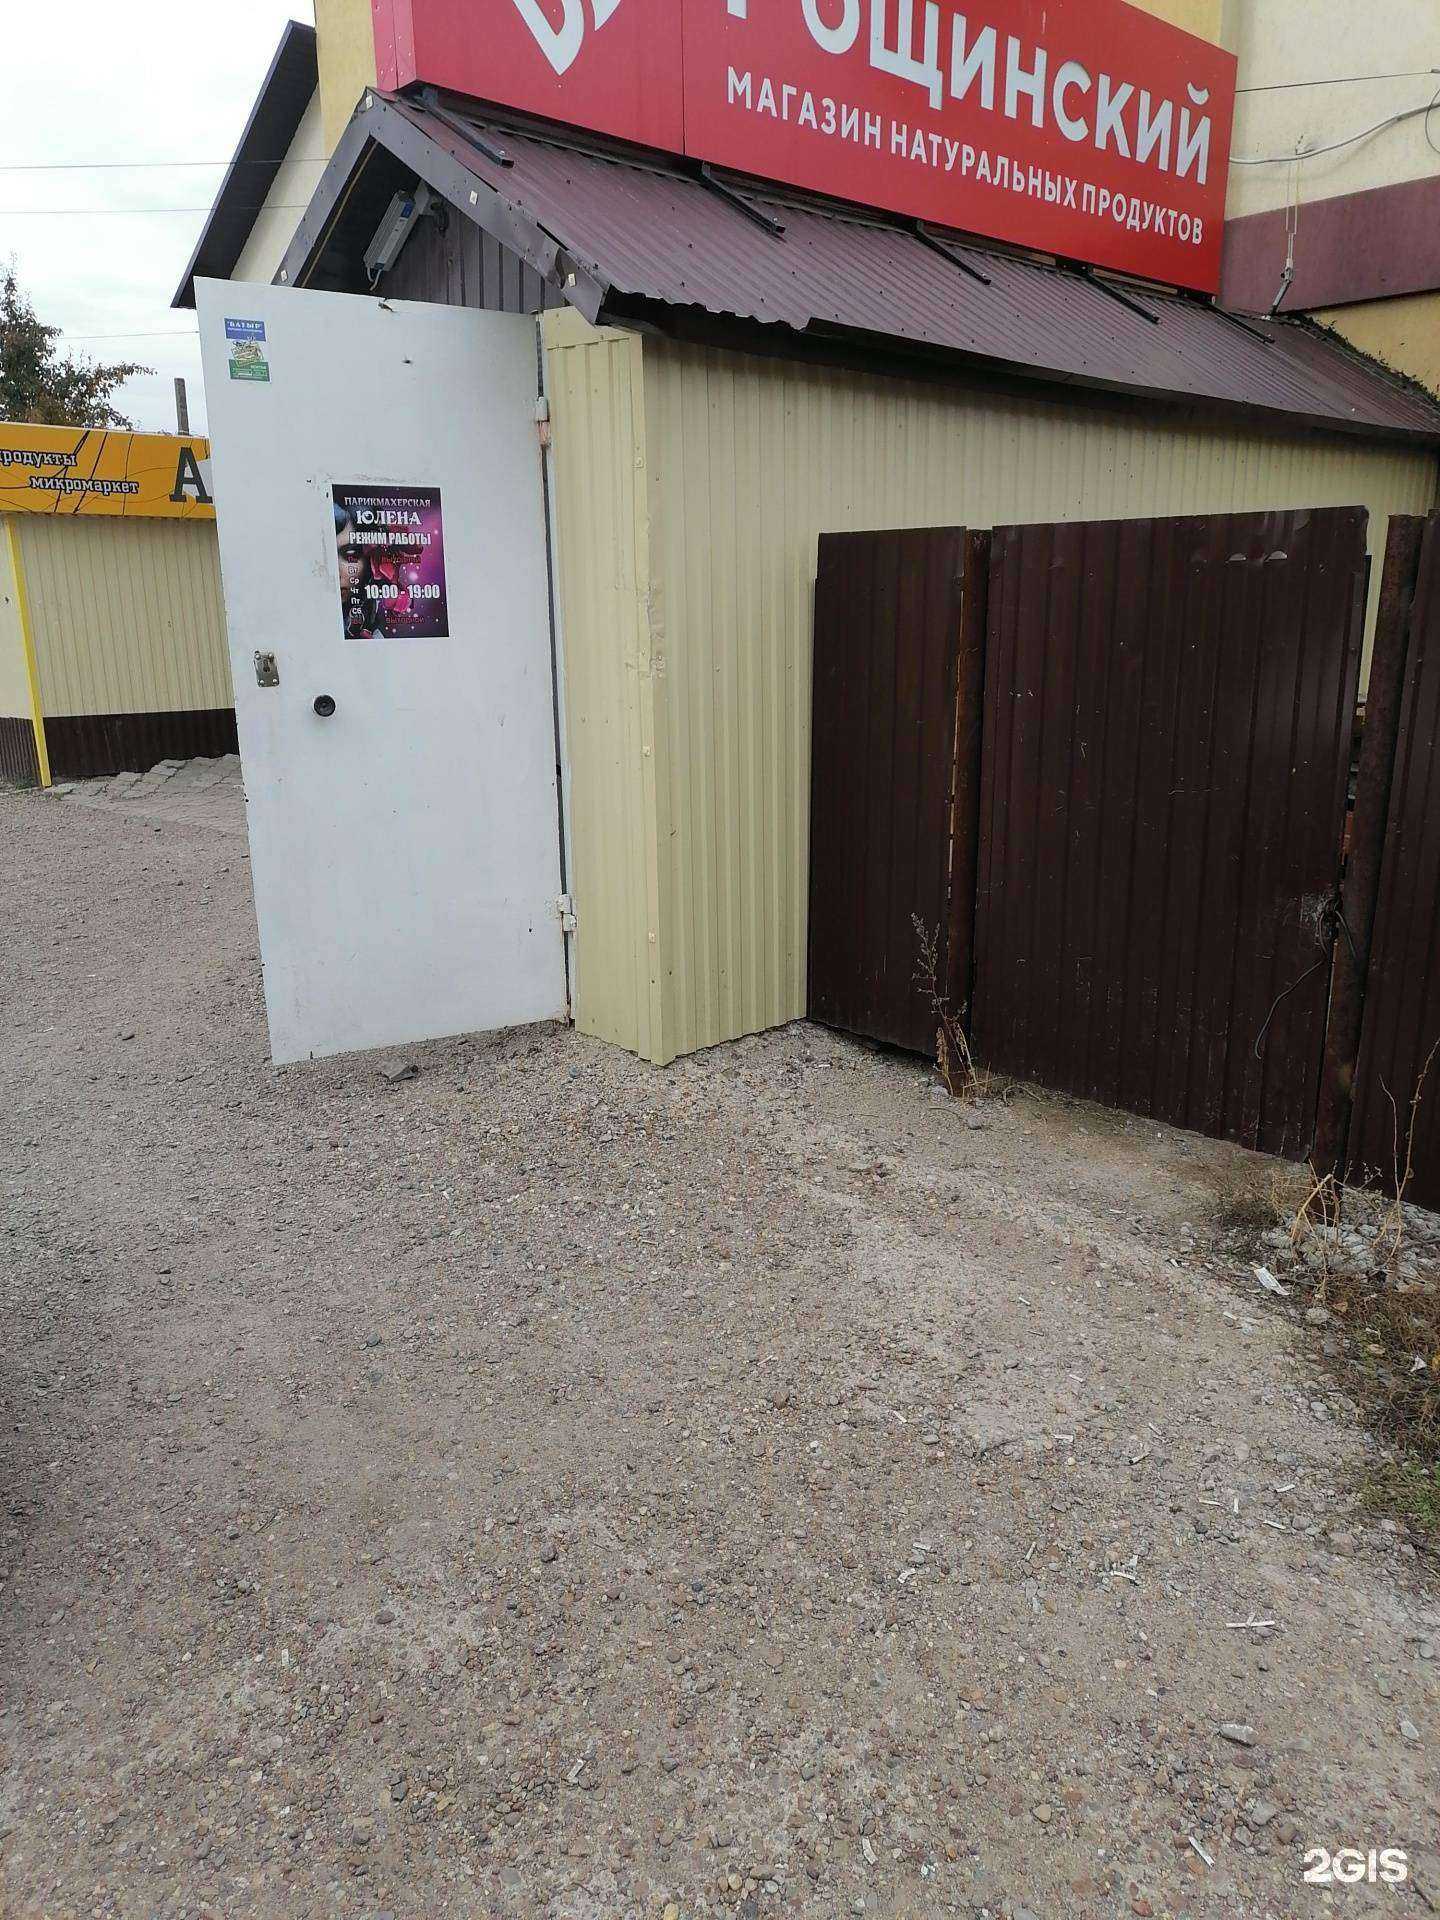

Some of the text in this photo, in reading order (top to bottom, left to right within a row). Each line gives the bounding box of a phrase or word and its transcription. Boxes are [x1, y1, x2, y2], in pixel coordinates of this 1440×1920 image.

[727, 0, 1211, 185] ОЩИНСКИЙ
[727, 65, 1204, 246] МАГАЗИН НАТУРАЛЬНЫХ ПРОДУКТОВ
[0, 450, 77, 468] родукты
[30, 476, 139, 496] микромаркет
[344, 497, 431, 508] ПАРИКМАХЕРСКАЯ
[356, 510, 422, 525] ЮЛЕНА
[349, 532, 432, 545] РЕЖИМ РАБОТЫ
[364, 584, 398, 599] 10:00
[407, 584, 441, 599] 19:00
